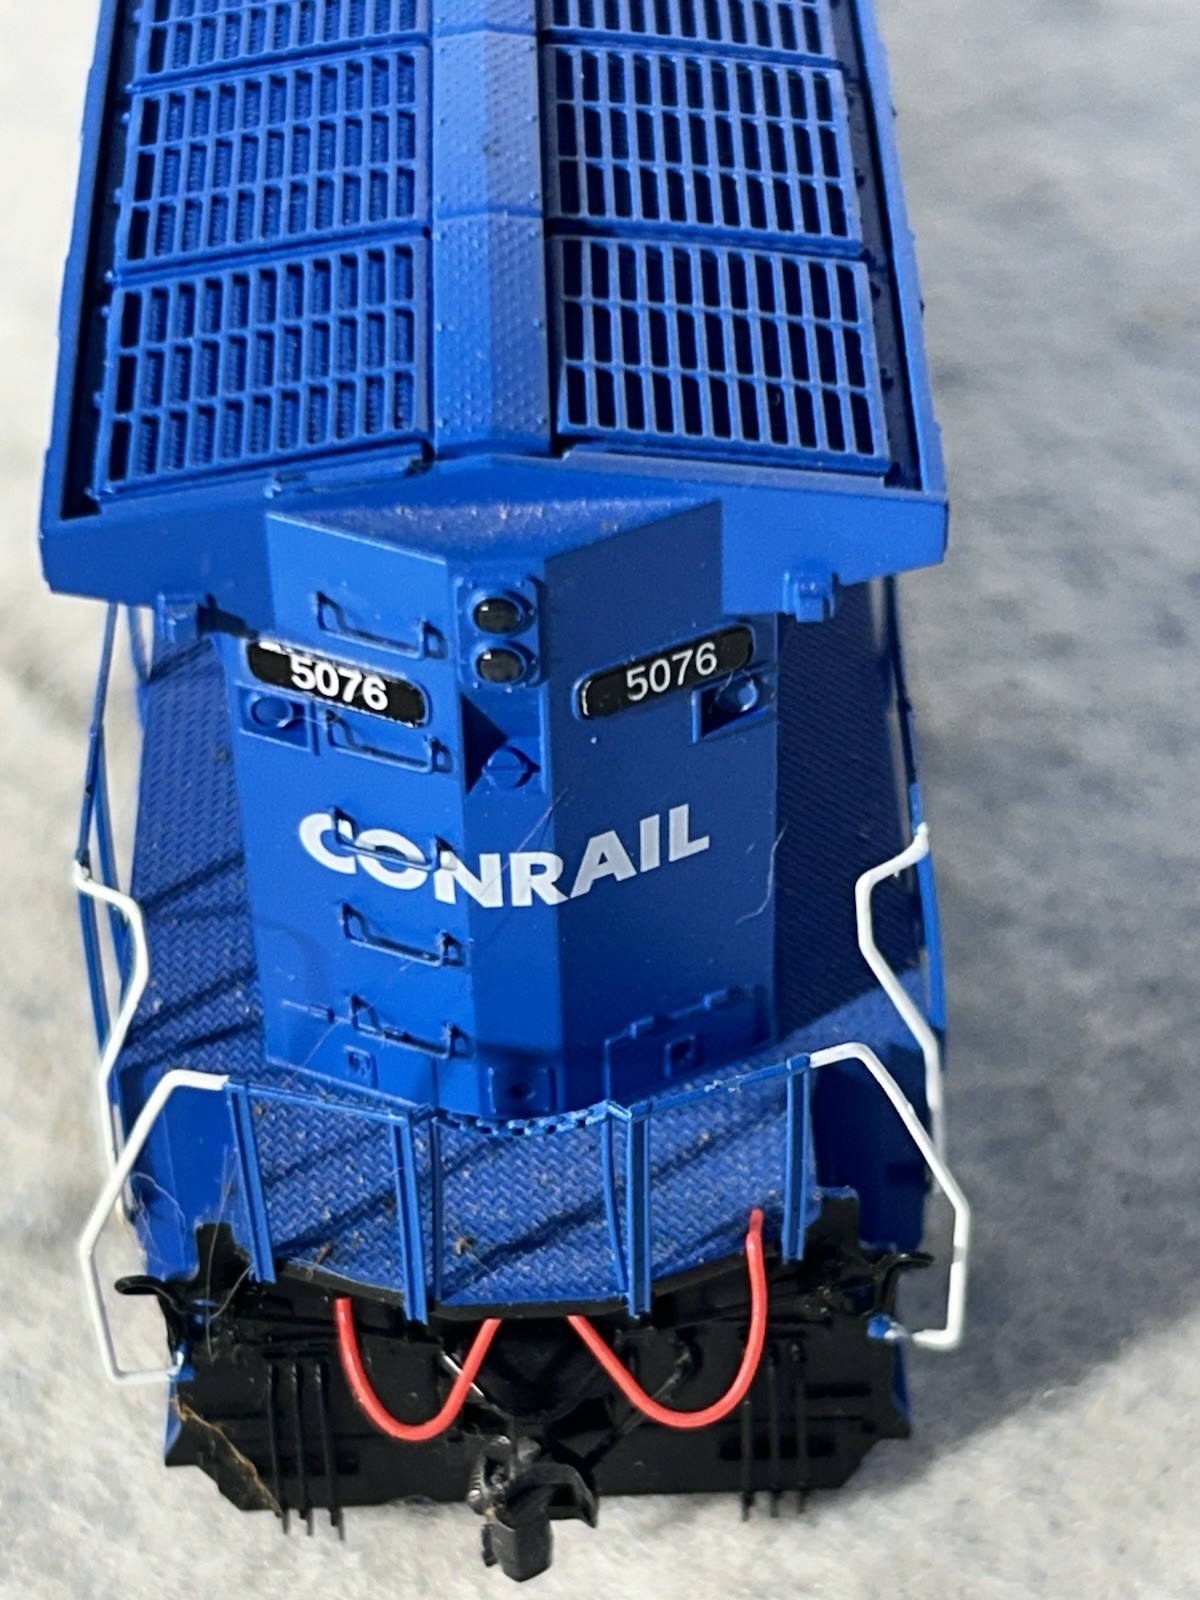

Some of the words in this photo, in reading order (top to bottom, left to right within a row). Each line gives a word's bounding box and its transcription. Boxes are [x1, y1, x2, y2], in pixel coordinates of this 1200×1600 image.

[290, 656, 388, 711] 5076
[625, 641, 719, 702] 5076
[299, 803, 710, 909] CONRAIL
